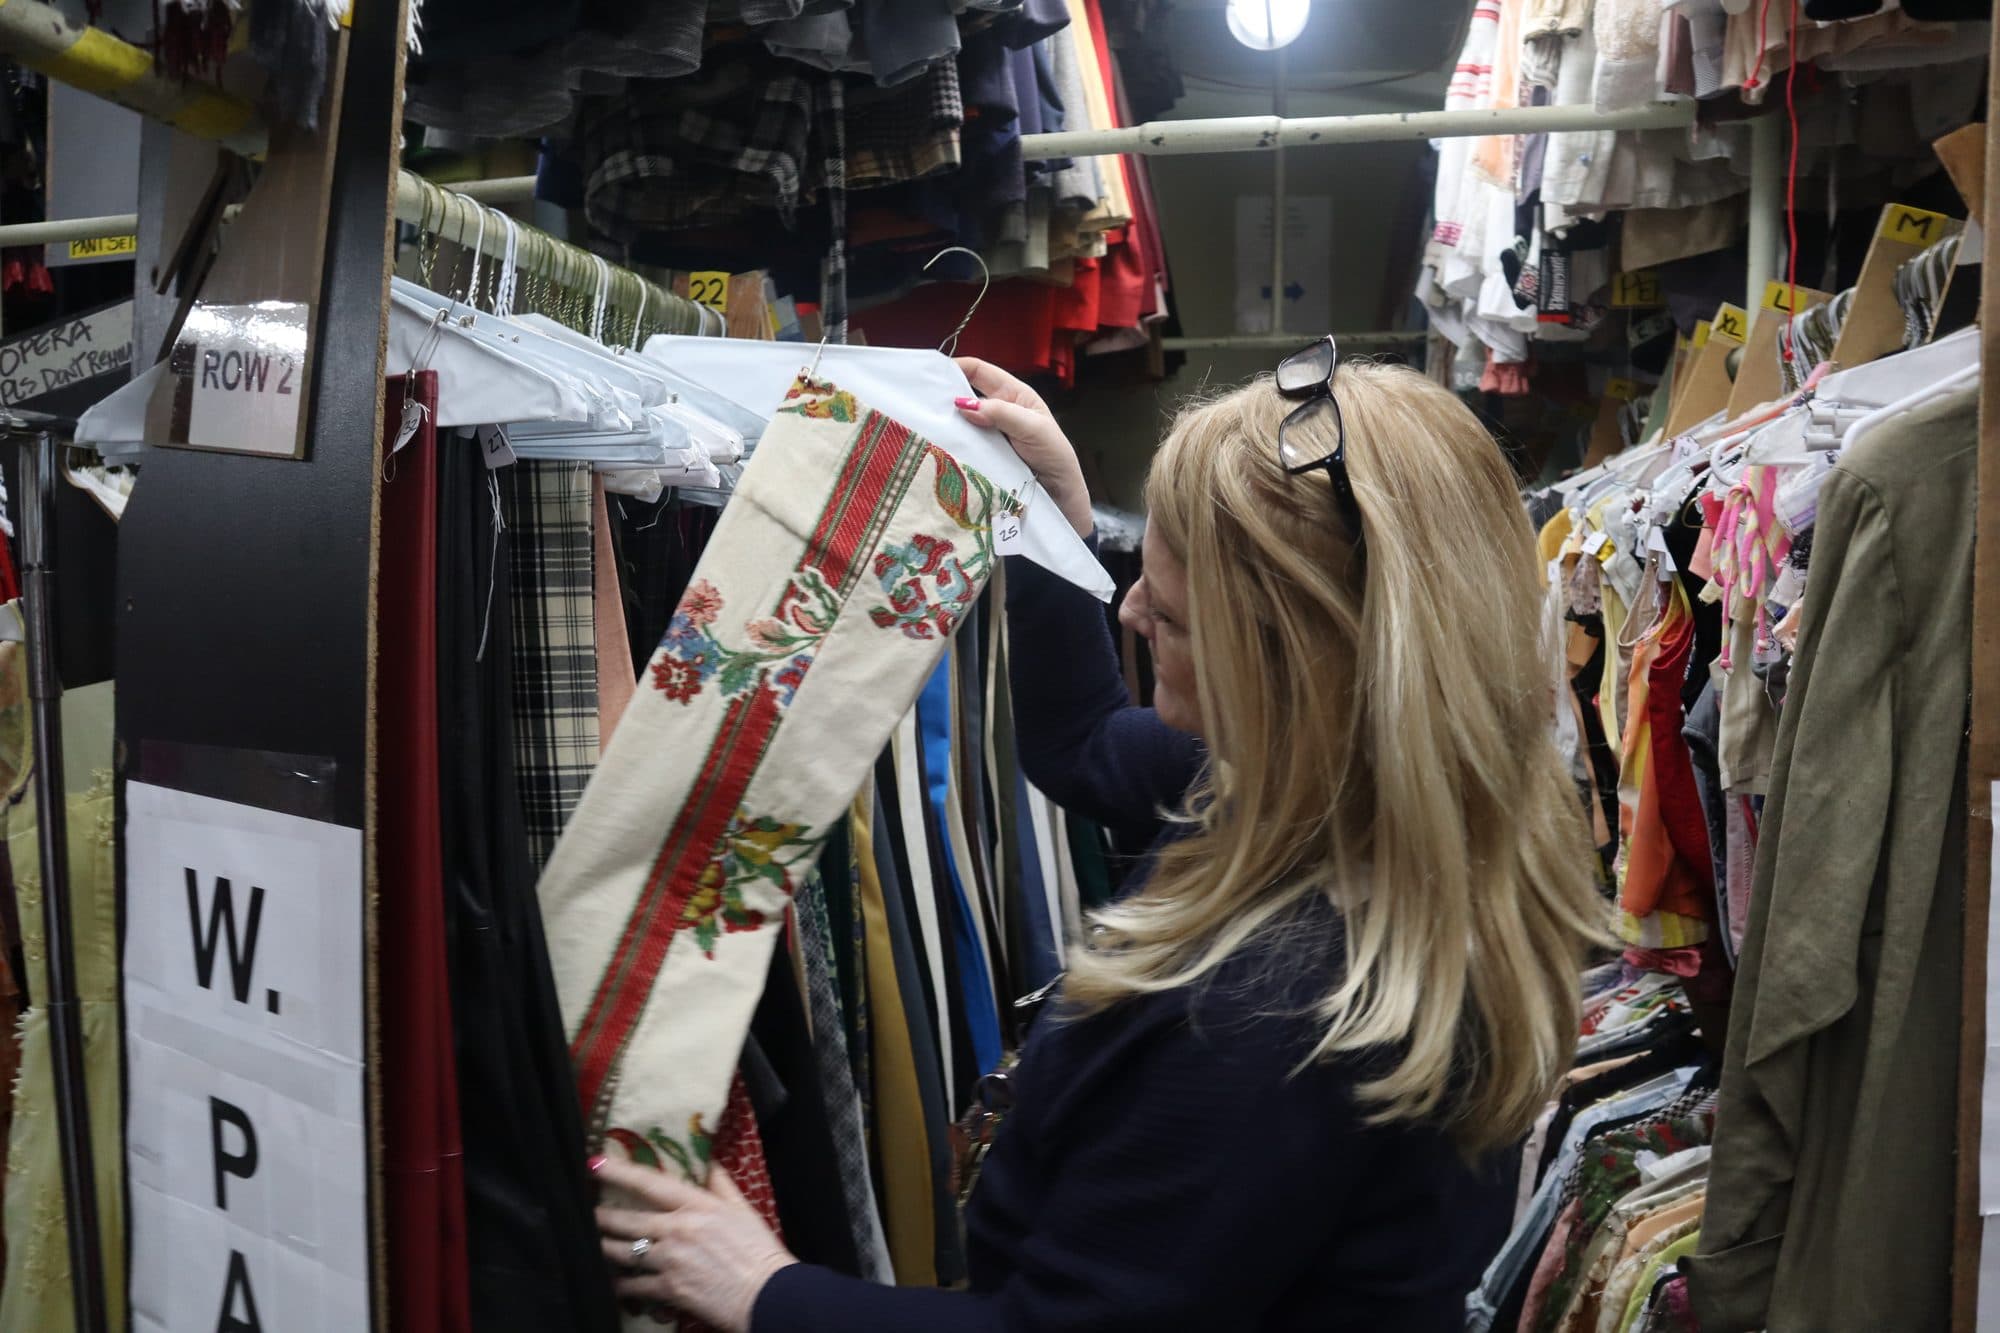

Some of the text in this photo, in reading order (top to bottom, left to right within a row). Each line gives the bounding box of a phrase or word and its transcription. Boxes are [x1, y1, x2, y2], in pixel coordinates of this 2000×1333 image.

[1896, 212, 1933, 240] M
[691, 278, 724, 305] 22
[1773, 288, 1791, 312] L
[1716, 312, 1741, 337] XL
[0, 320, 92, 377] OPERA
[202, 350, 294, 394] ROW 2
[0, 376, 36, 406] PLS
[488, 431, 505, 454] 27
[999, 525, 1018, 542] 25
[183, 867, 280, 1016] W.
